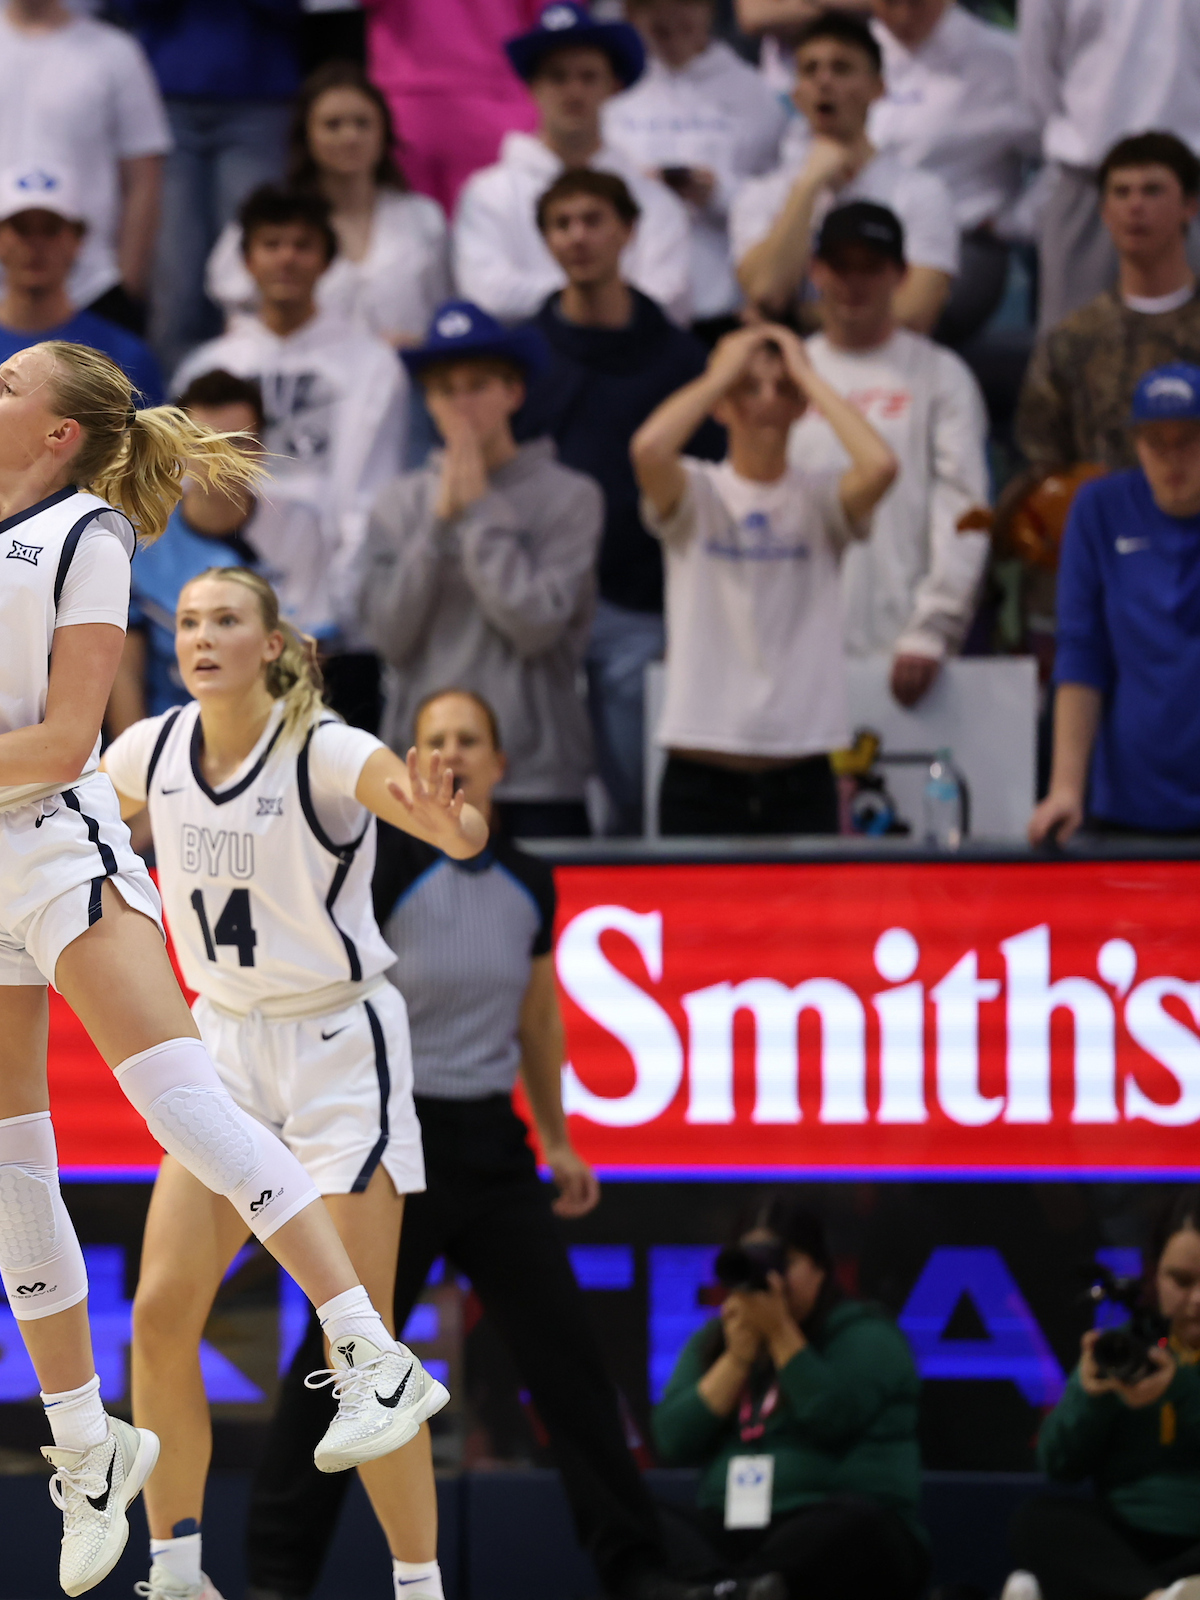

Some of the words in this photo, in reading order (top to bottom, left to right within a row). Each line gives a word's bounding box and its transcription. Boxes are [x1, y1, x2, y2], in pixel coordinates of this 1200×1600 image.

[181, 823, 255, 880] BYU
[190, 888, 257, 967] 14
[555, 905, 1200, 1127] Smith's
